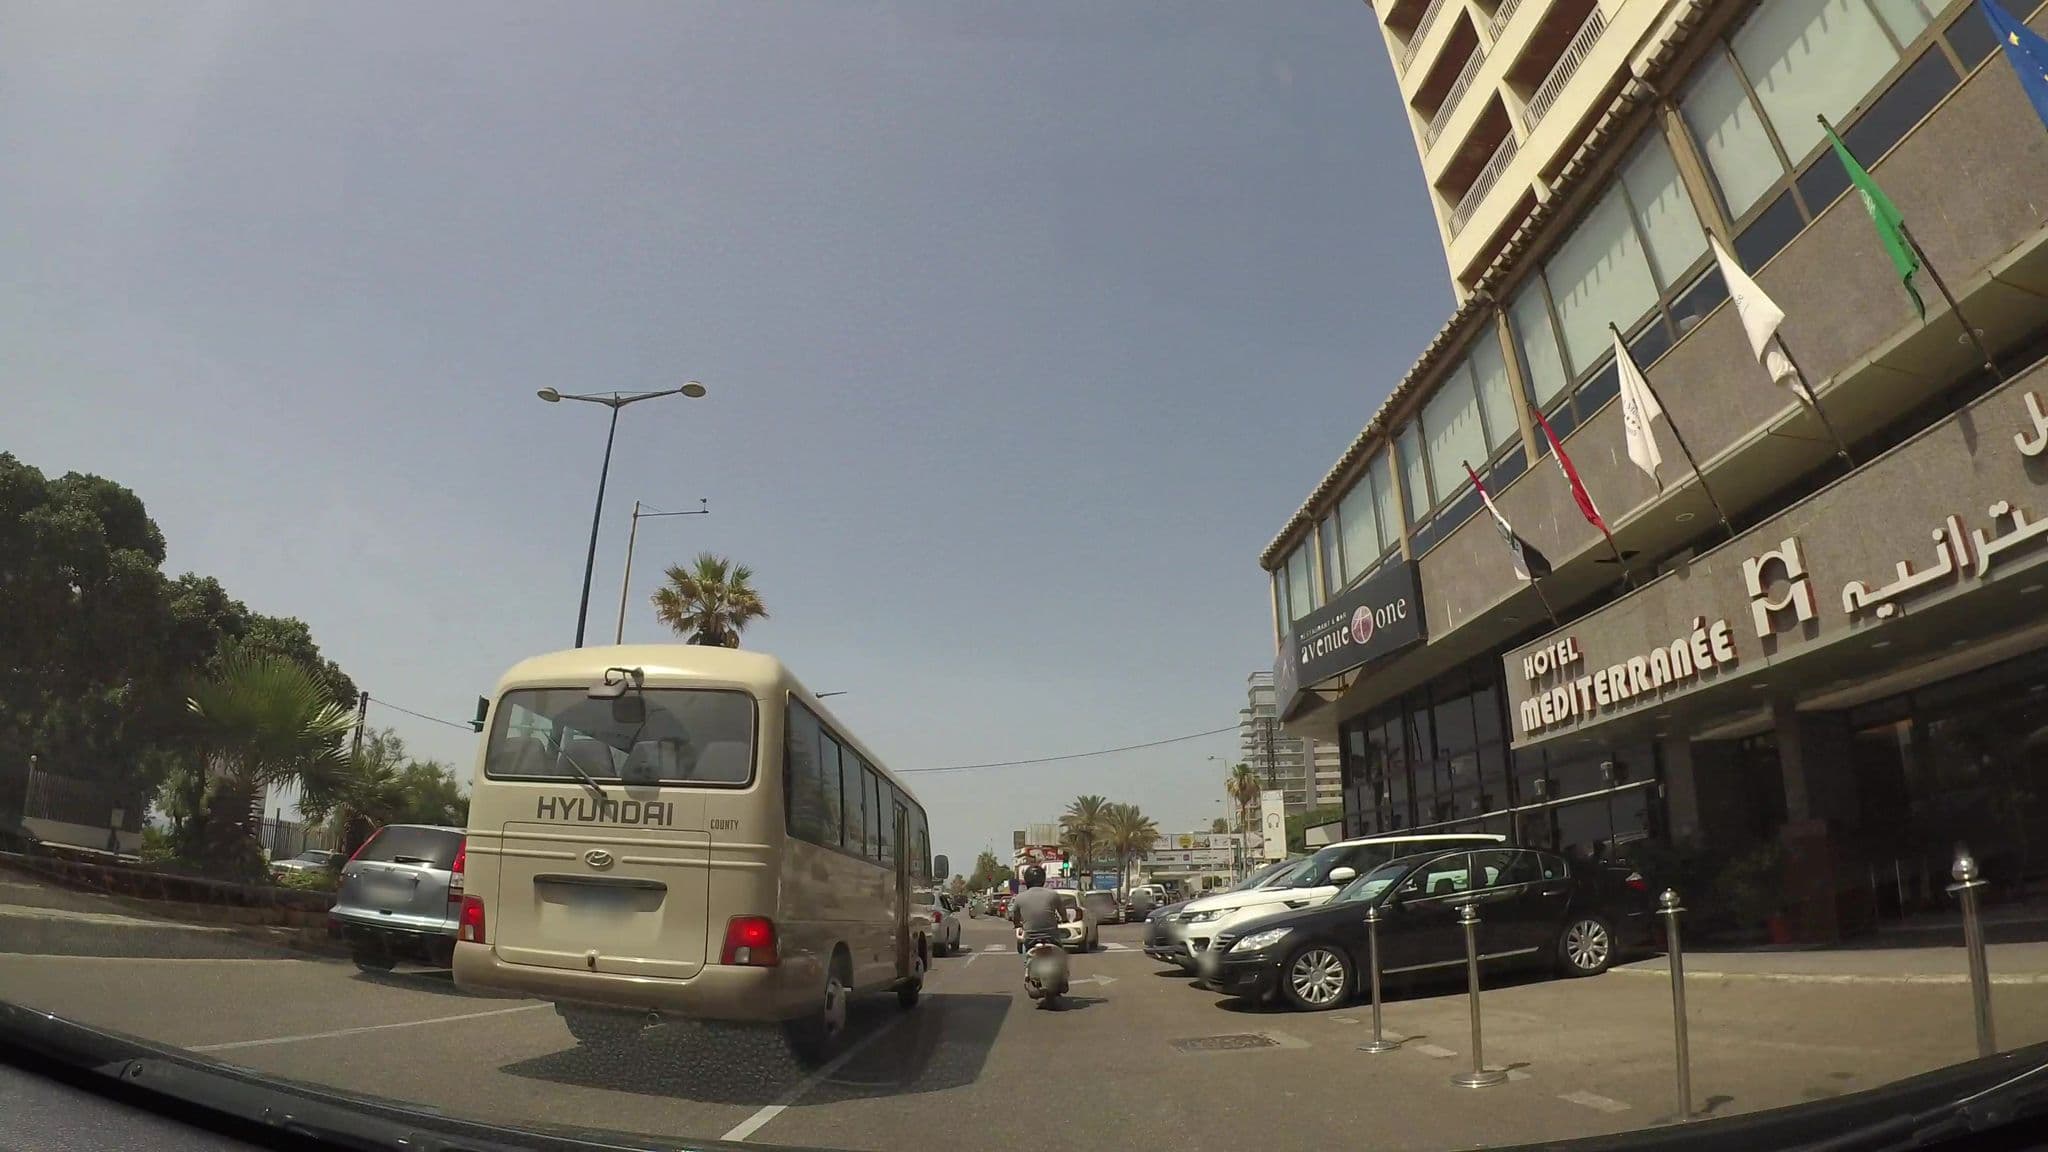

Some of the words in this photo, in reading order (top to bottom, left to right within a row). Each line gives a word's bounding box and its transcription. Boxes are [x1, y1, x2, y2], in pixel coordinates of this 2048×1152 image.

[1302, 626, 1349, 664] avenue
[1375, 598, 1407, 628] one
[1520, 616, 1734, 732] MEDITERRANÉE
[1523, 637, 1579, 681] HOTEL
[537, 796, 673, 825] HYUNDAI
[710, 818, 739, 830] COUNTY
